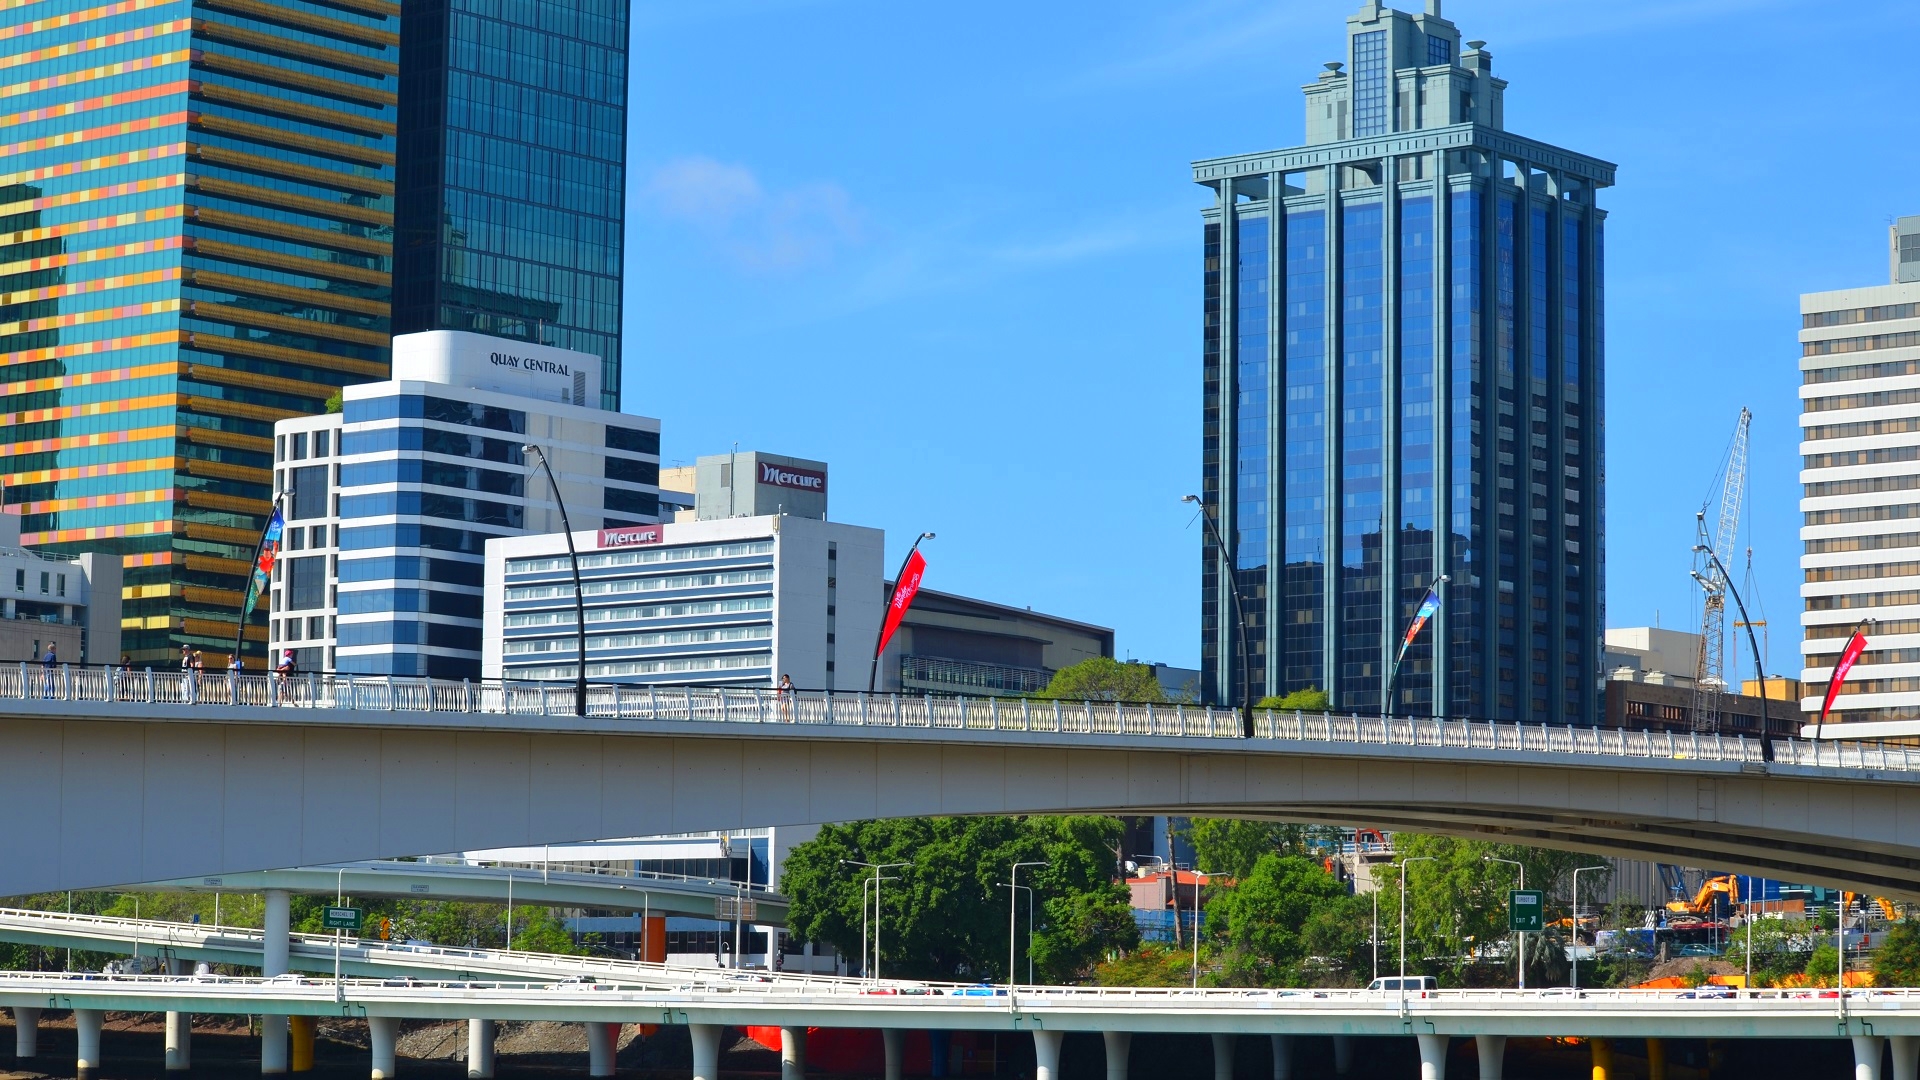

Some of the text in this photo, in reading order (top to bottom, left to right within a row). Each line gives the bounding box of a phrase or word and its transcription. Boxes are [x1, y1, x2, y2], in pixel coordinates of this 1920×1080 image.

[490, 352, 570, 376] QUAY CENTRAL
[761, 462, 822, 488] Mercure
[603, 530, 657, 545] Mercure
